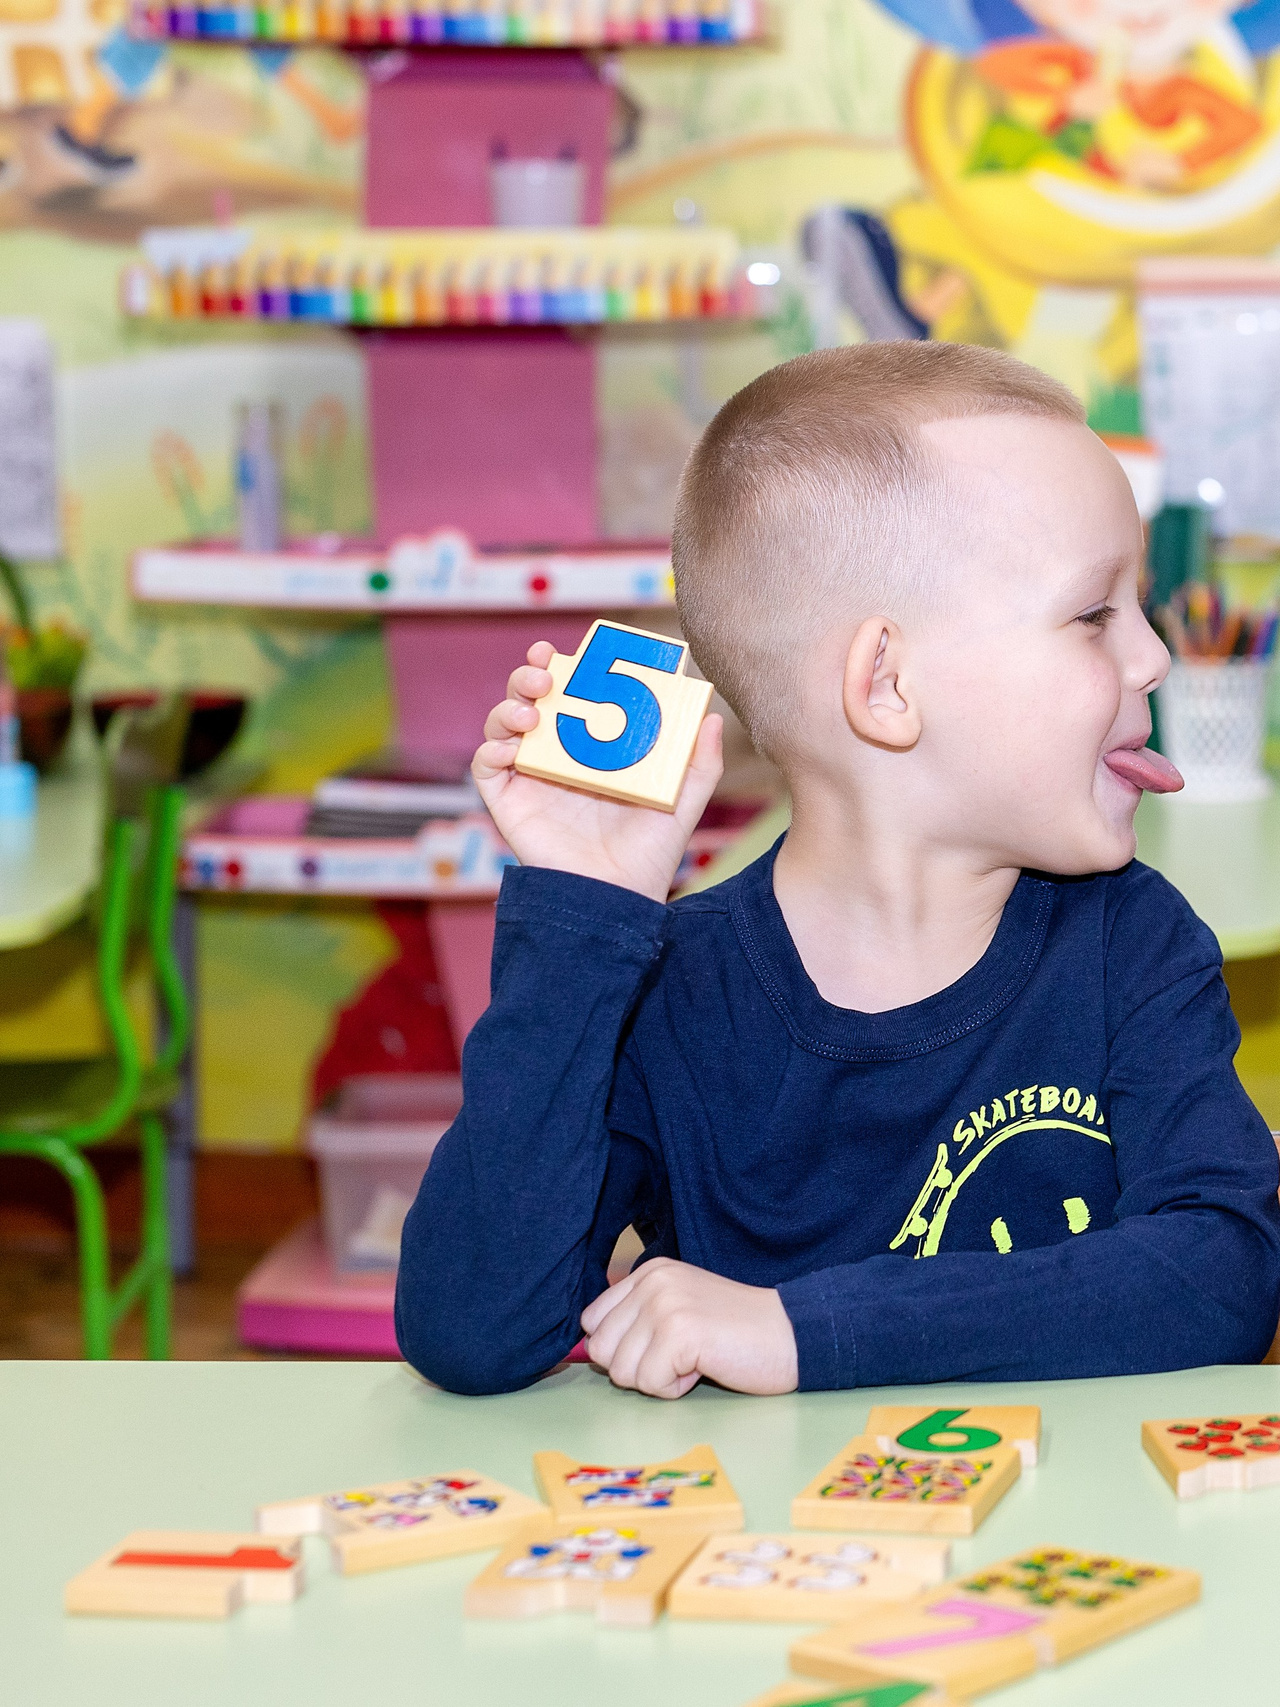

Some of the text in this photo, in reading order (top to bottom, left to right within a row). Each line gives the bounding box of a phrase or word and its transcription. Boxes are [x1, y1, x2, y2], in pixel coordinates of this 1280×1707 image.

[556, 624, 684, 771] 5
[953, 1085, 1105, 1156] SKATEBOA
[896, 1408, 1002, 1453] 6
[110, 1546, 297, 1571] 1
[854, 1597, 1044, 1658] 7
